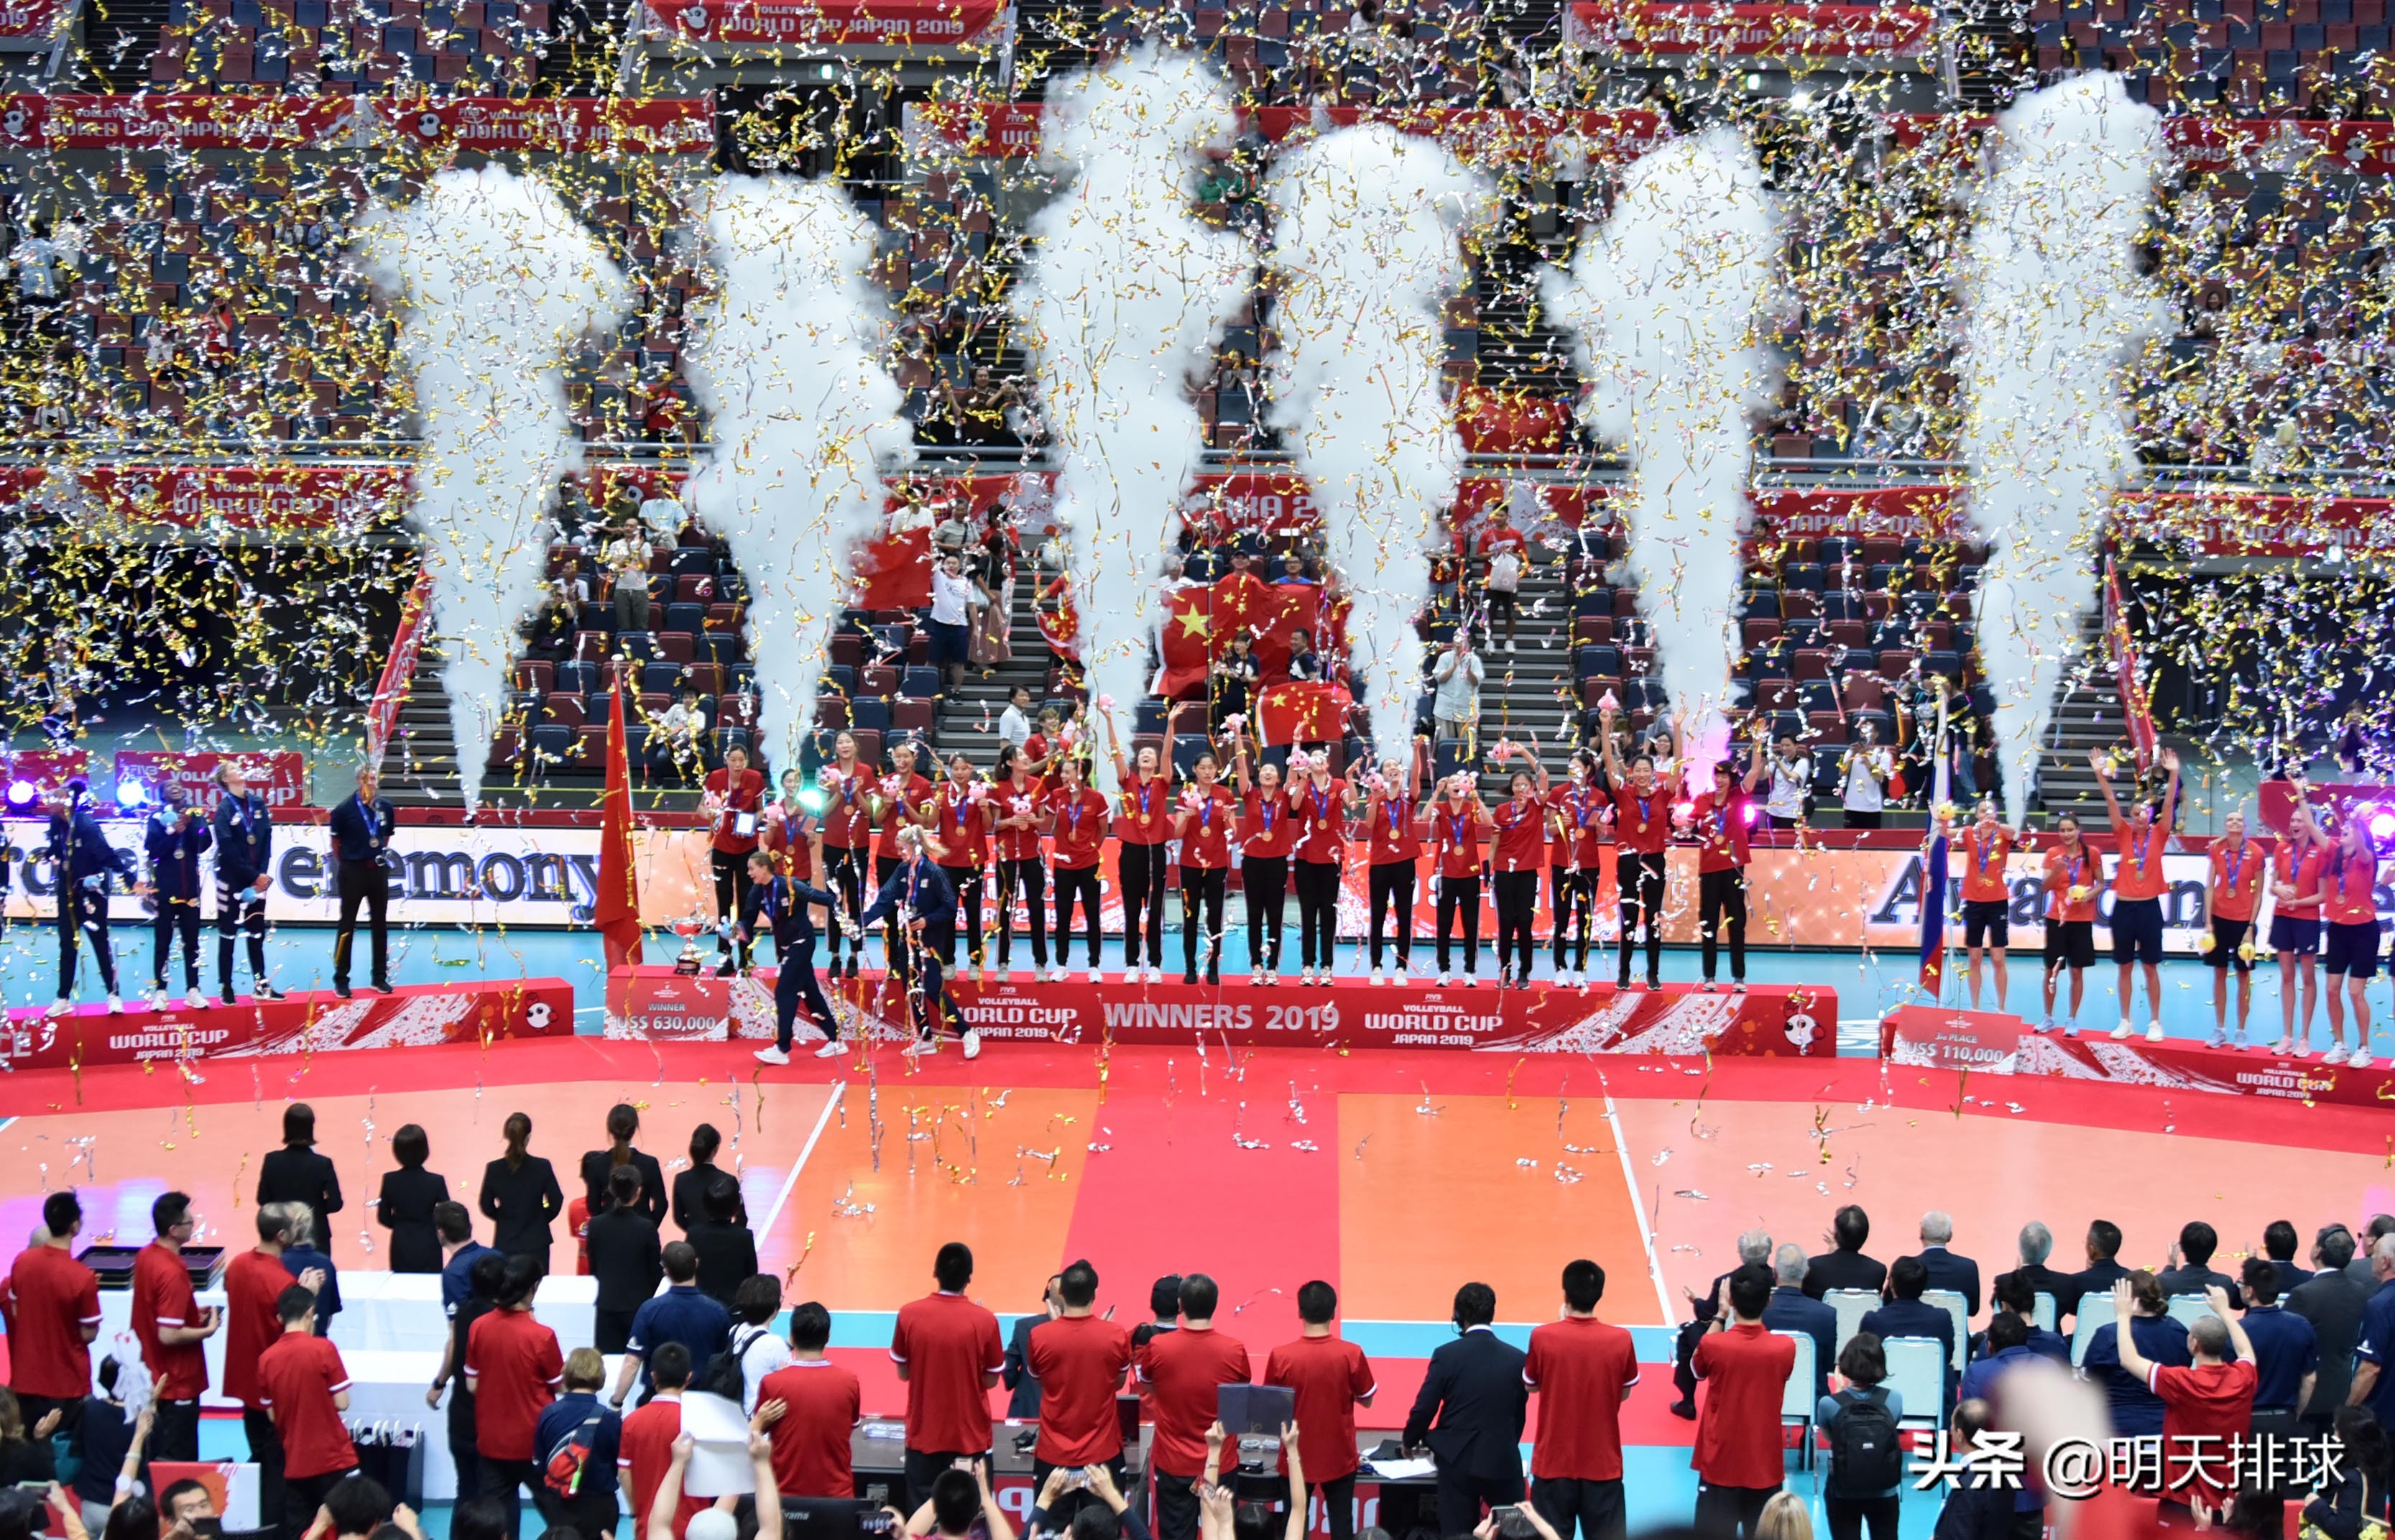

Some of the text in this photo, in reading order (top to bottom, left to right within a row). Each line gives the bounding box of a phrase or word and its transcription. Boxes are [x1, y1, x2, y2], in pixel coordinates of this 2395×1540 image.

[721, 17, 794, 32] WORLD
[848, 20, 910, 33] JAPAN
[916, 20, 964, 34] 2019
[648, 1003, 686, 1012] WINNER
[1403, 1005, 1465, 1013] VOLLEYBALL
[617, 1016, 716, 1032] US$ 630,000
[959, 1008, 1077, 1024] ORLD CUP
[1103, 1003, 1340, 1030] WINNERS 2019
[1365, 1014, 1503, 1031] WORLD CUP
[109, 1029, 229, 1049] WORLD CUP
[970, 1027, 1049, 1038] JAPAN 2019
[1392, 1034, 1475, 1046] JAPAN 2019
[1949, 1033, 1978, 1043] PLACE
[134, 1048, 173, 1061] JAPAN
[1906, 1043, 2004, 1062] US$ 110,000
[2236, 1072, 2294, 1088] WORLD
[2255, 1087, 2286, 1097] JAPAN
